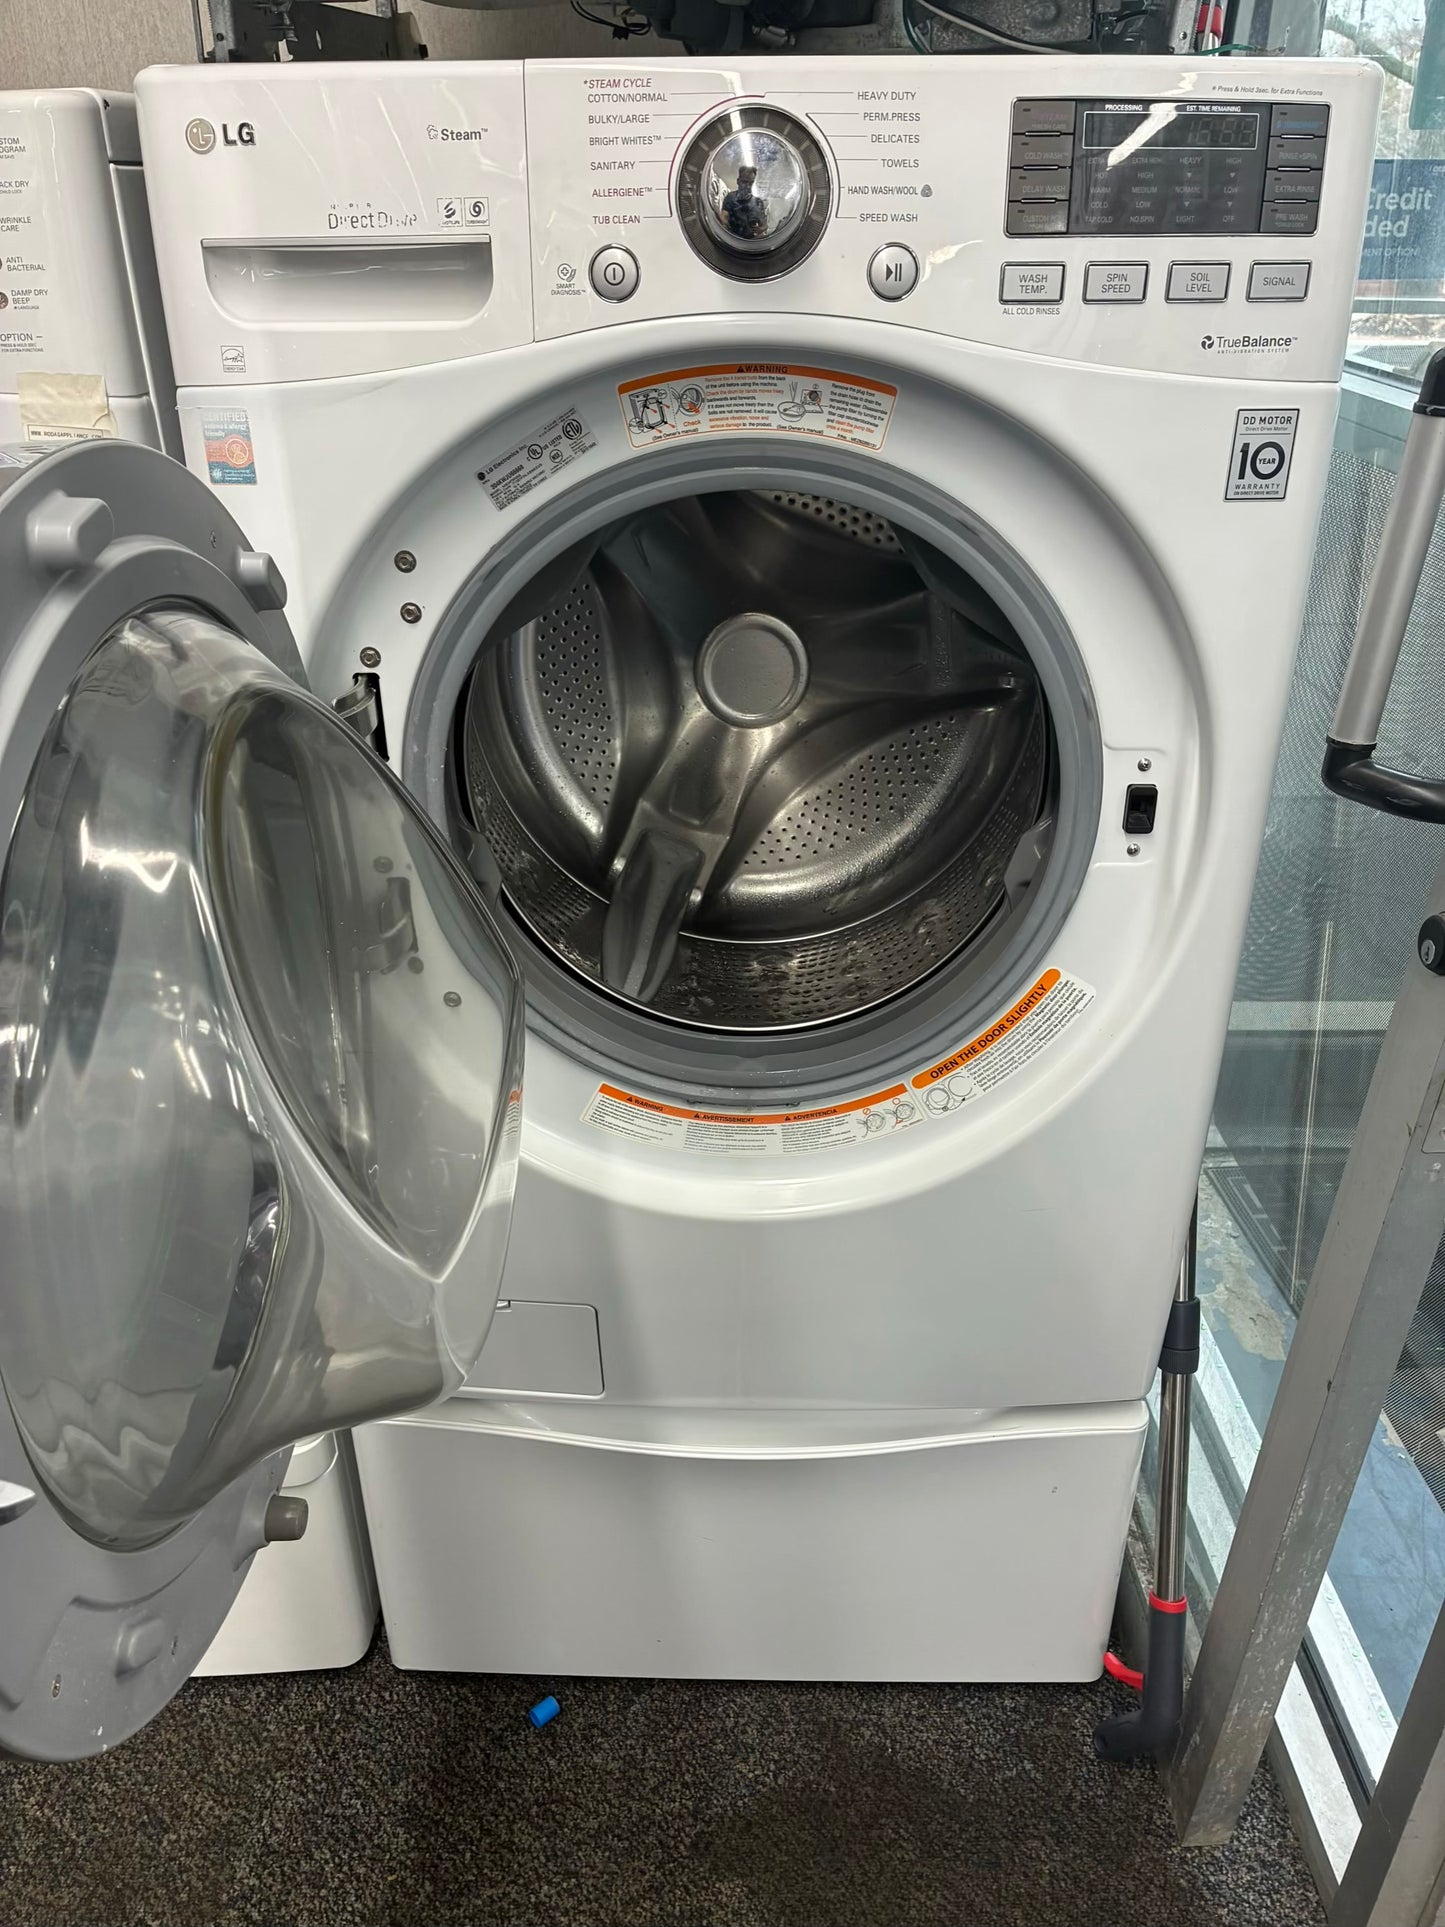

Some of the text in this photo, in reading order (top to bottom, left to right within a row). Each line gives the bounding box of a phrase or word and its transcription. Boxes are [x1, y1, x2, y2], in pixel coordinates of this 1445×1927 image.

[623, 78, 652, 88] CYCLE
[857, 91, 916, 101] HEAVY DUTY
[1295, 88, 1323, 96] Functions
[587, 93, 668, 103] COTTON/NORMAL
[588, 114, 650, 124] BULKY/LARGE
[863, 112, 921, 122] PERM.PRESS
[222, 121, 256, 147] LG
[871, 134, 920, 144] DELICATES
[589, 136, 619, 146] BRIGHT
[590, 161, 636, 171] SANITARY
[881, 158, 920, 168] TOWELS
[14, 180, 29, 188] DRY
[847, 185, 918, 196] HAND WASH/WOOL
[0, 216, 32, 224] WRINKLE
[592, 215, 641, 225] TUB CLEAN
[859, 213, 918, 223] SPEED WASH
[7, 264, 46, 272] BACTERIAL
[1018, 274, 1048, 284] WASH
[1106, 273, 1128, 283] SPIN
[1189, 272, 1211, 282] SOIL
[1262, 276, 1296, 287] SIGNAL
[11, 289, 33, 297] DAMP
[1019, 284, 1048, 294] TEMP.
[1101, 283, 1131, 294] SPEED
[1185, 283, 1212, 293] LEVEL
[12, 297, 31, 305] BEEP
[1002, 308, 1060, 316] ALL COLD RINSES
[0, 333, 33, 342] OPTION
[744, 365, 788, 373] WARNING
[1243, 416, 1293, 425] DD MOTOR
[1238, 441, 1286, 480] 10
[929, 983, 1047, 1080] OPEN THE DOOR SLIGHTLY
[634, 1099, 663, 1112] WARNING
[793, 1109, 838, 1121] ADVERTENCIA
